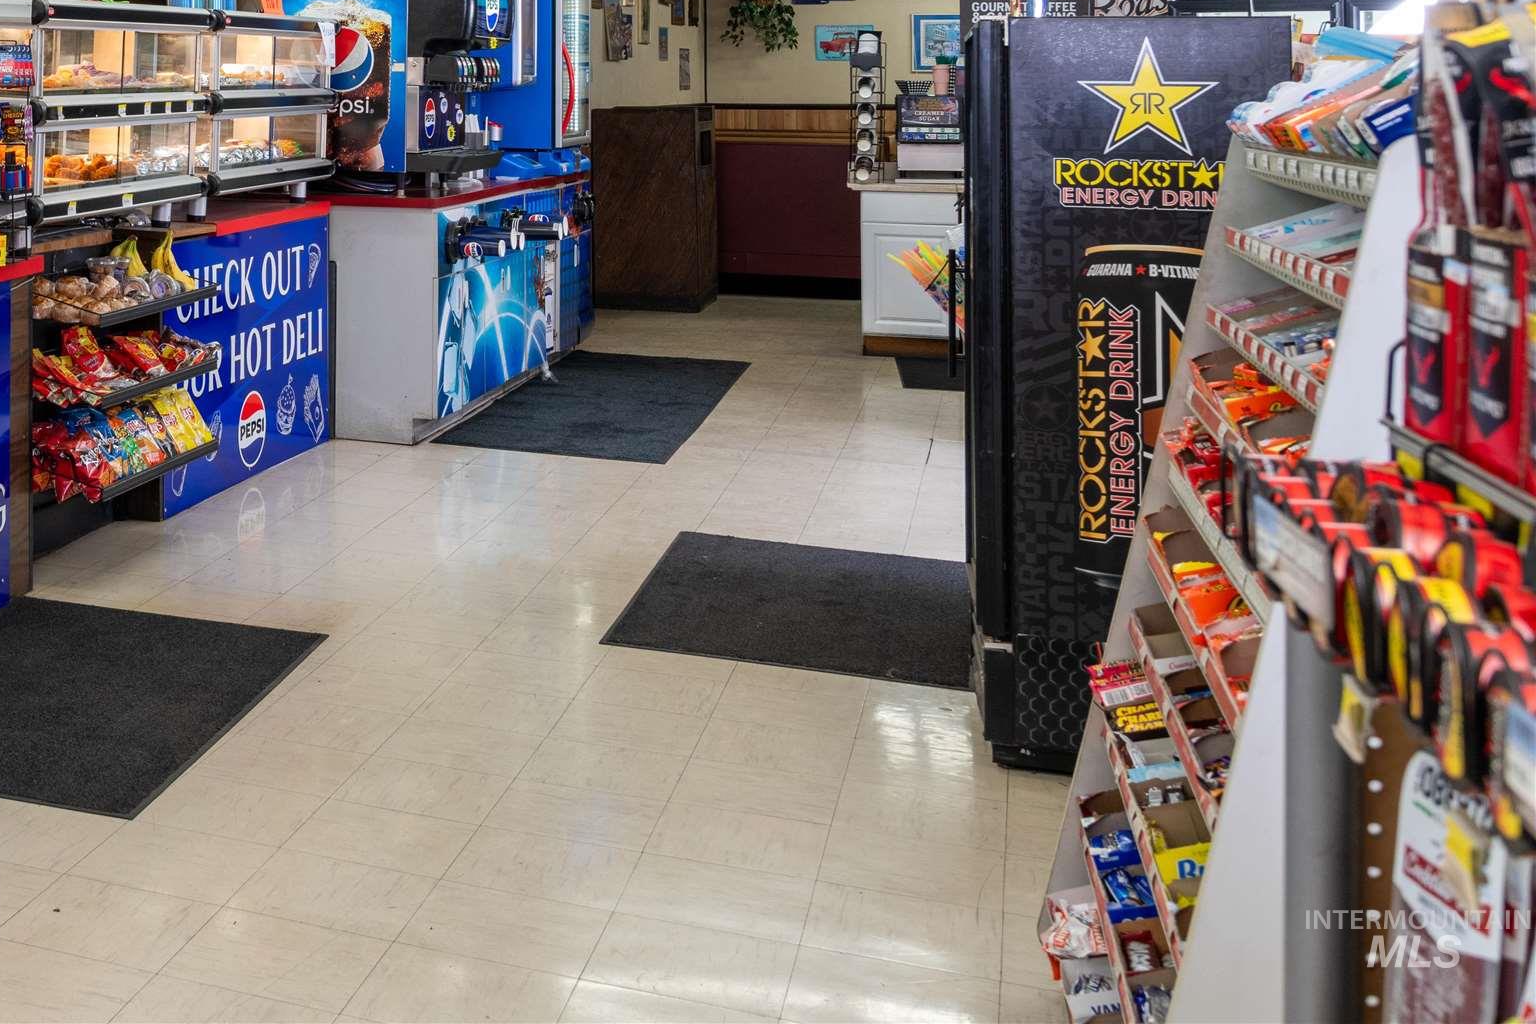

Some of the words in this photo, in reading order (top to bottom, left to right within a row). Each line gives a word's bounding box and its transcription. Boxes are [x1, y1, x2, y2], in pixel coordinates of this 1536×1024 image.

[972, 2, 1027, 11] GOURMT
[1062, 187, 1154, 205] ENERGY
[176, 256, 255, 324] CHECK
[262, 244, 304, 300] OUT
[1087, 264, 1132, 276] GUARANA
[230, 323, 275, 384] HOT
[282, 308, 323, 365] DELI
[1108, 308, 1134, 400] DRINK
[240, 419, 264, 440] PEPSI
[1109, 412, 1135, 536] ENERGY
